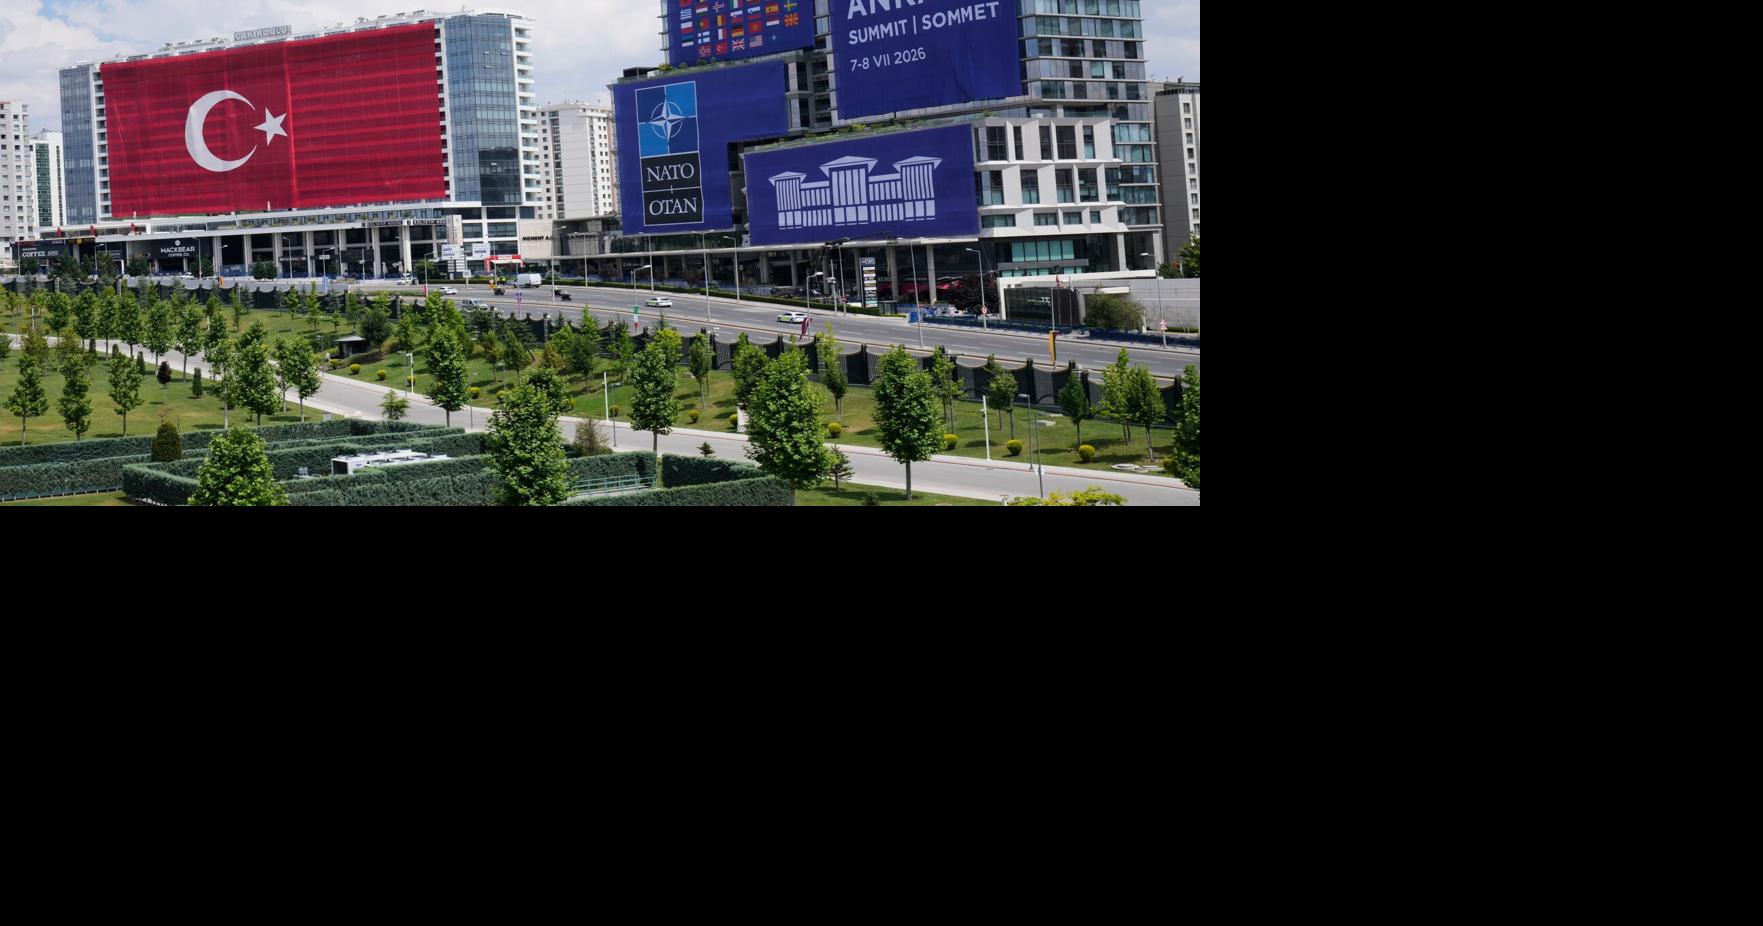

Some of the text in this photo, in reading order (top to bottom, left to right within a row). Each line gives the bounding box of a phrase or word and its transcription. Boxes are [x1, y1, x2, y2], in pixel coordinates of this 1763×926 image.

[848, 19, 908, 45] SUMMIT
[922, 1, 1000, 30] SOMMET
[850, 47, 926, 72] 7-8 VII 2026
[646, 162, 695, 182] NATO
[649, 197, 697, 216] OTAN
[22, 250, 46, 258] COFFEE
[160, 245, 196, 254] MACKBEAR
